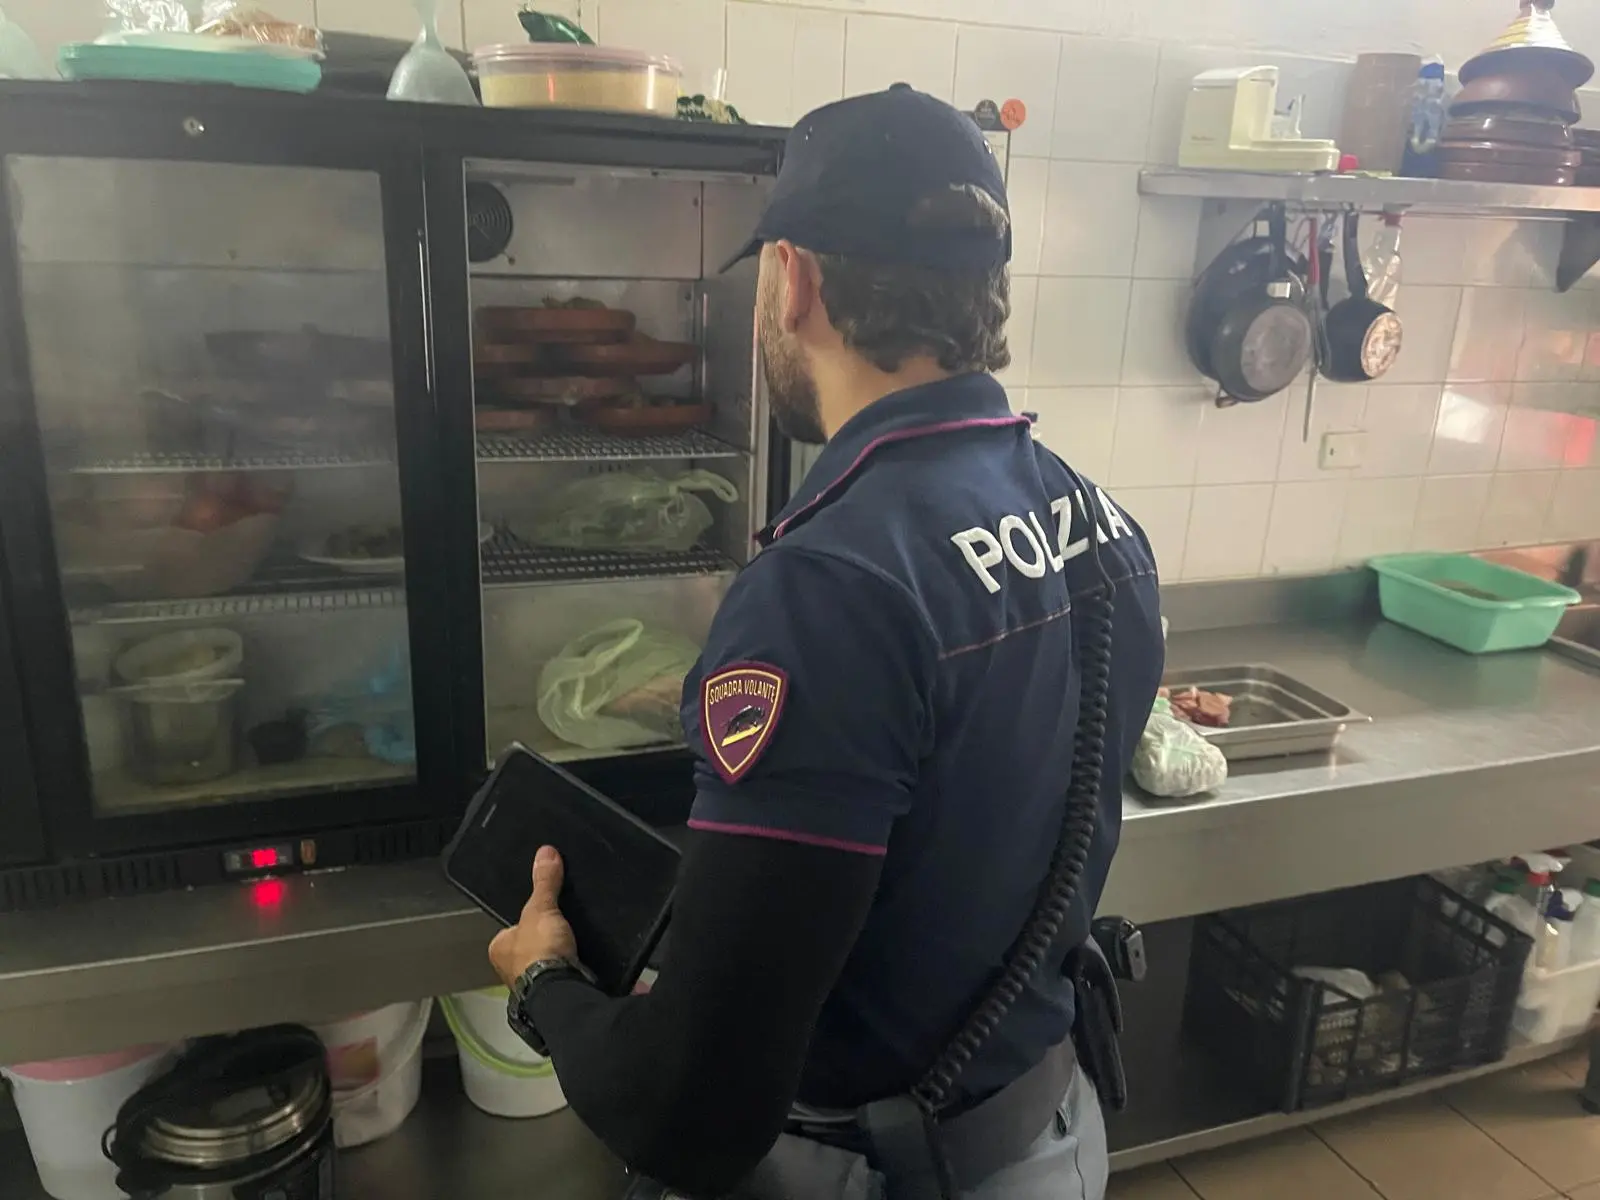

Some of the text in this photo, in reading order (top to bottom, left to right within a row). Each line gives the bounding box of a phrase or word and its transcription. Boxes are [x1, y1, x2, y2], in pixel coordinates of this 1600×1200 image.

[951, 487, 1134, 594] POLZIA
[709, 680, 776, 705] SQUADRA VOLANTE
